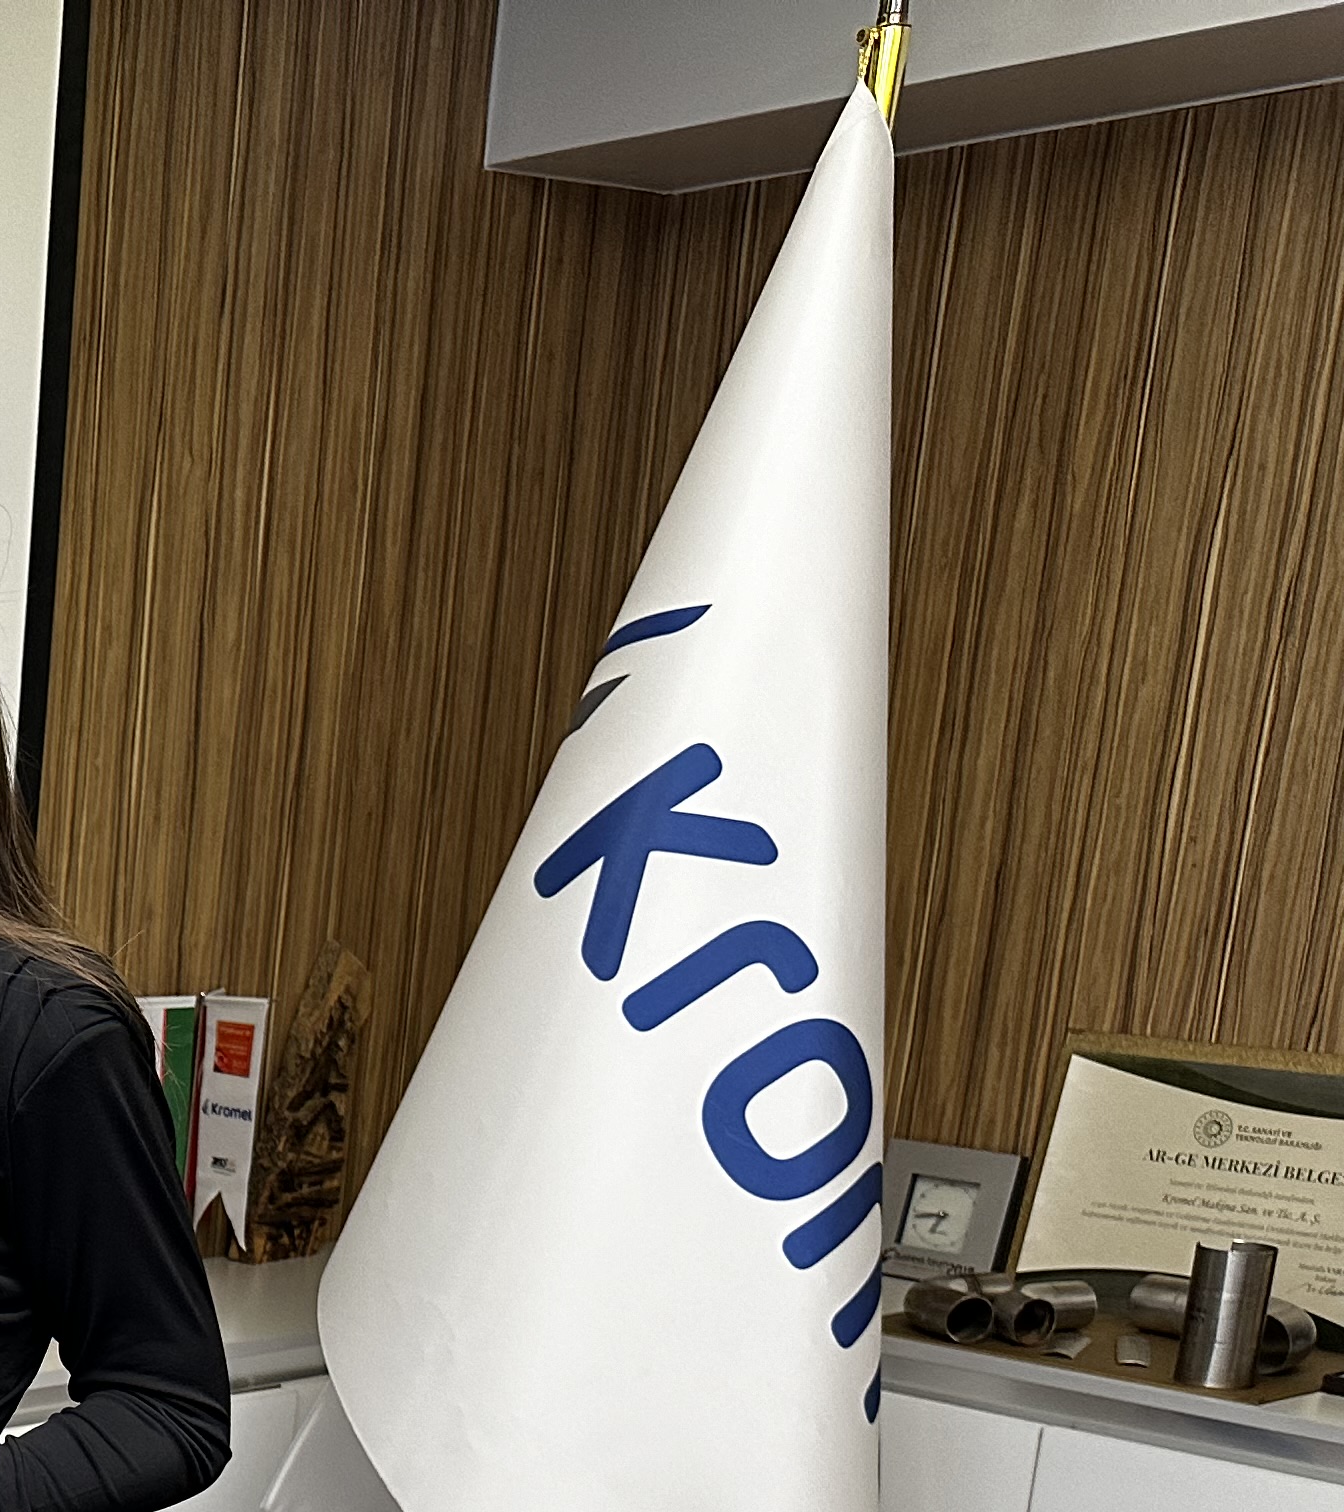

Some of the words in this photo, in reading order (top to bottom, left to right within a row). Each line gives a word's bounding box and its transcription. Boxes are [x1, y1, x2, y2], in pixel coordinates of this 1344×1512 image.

[1143, 1148, 1199, 1168] AR-GE
[1202, 1155, 1282, 1179] MERKEZİ
[1283, 1165, 1344, 1186] BELGE
